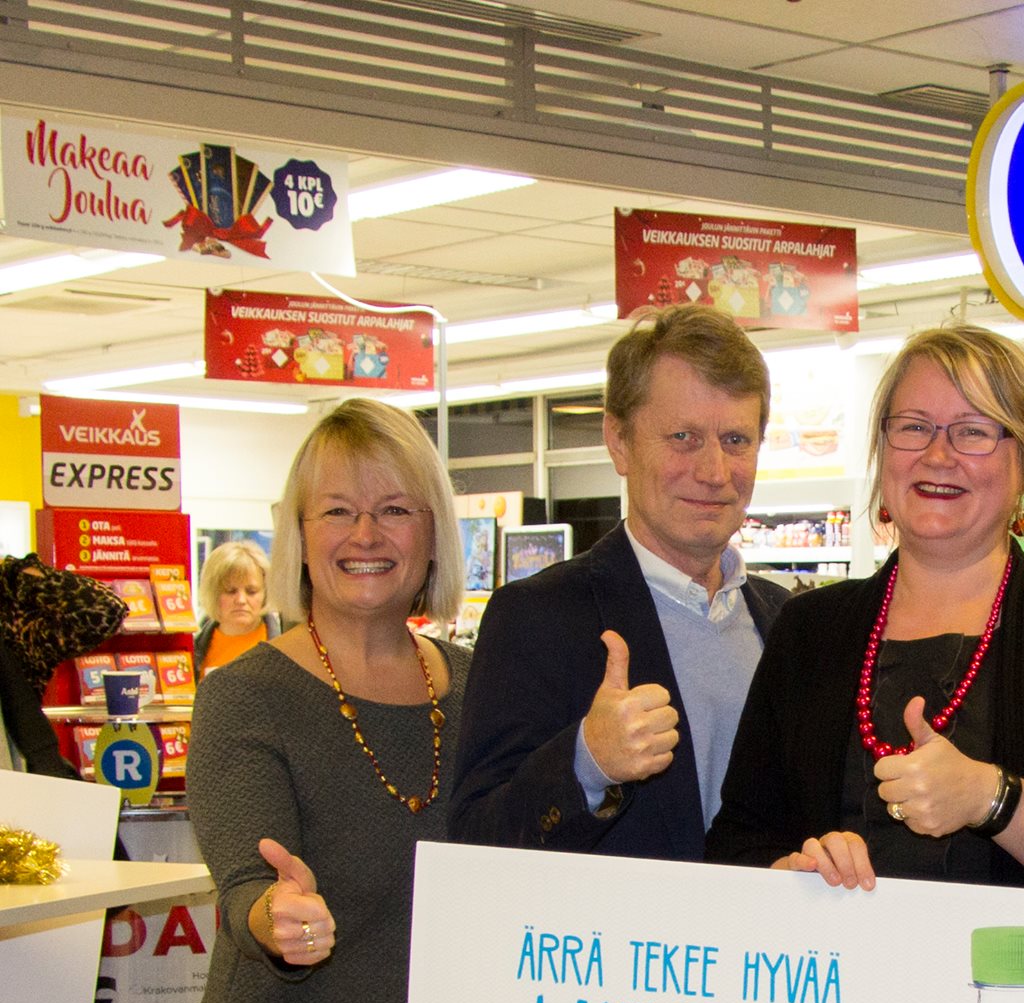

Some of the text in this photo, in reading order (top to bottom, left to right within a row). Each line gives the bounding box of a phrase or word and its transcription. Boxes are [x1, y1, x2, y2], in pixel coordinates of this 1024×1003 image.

[26, 118, 153, 180] Makeaa
[284, 174, 323, 192] 4 KPL
[48, 167, 152, 224] Joulua
[287, 190, 324, 217] 10€
[642, 229, 836, 258] VEIKKAUKSEN SUOSITUT ARPALAHJAT
[231, 305, 415, 331] VEIKKAUKSEN SUOSITUT ARPALAHJAT
[60, 424, 161, 447] VEIKKAUS
[50, 462, 175, 491] EXPRESS
[92, 520, 110, 531] OTA
[92, 535, 125, 546] MAKSA
[92, 549, 131, 562] JÄNNITÄ
[166, 598, 185, 611] 6€
[84, 655, 111, 665] LOTTO
[123, 655, 151, 664] LOTTO
[166, 670, 186, 683] 6€
[165, 740, 184, 755] 6€
[112, 750, 142, 781] R
[517, 925, 603, 988] ÄRRÄ
[629, 940, 719, 998] TEKEE
